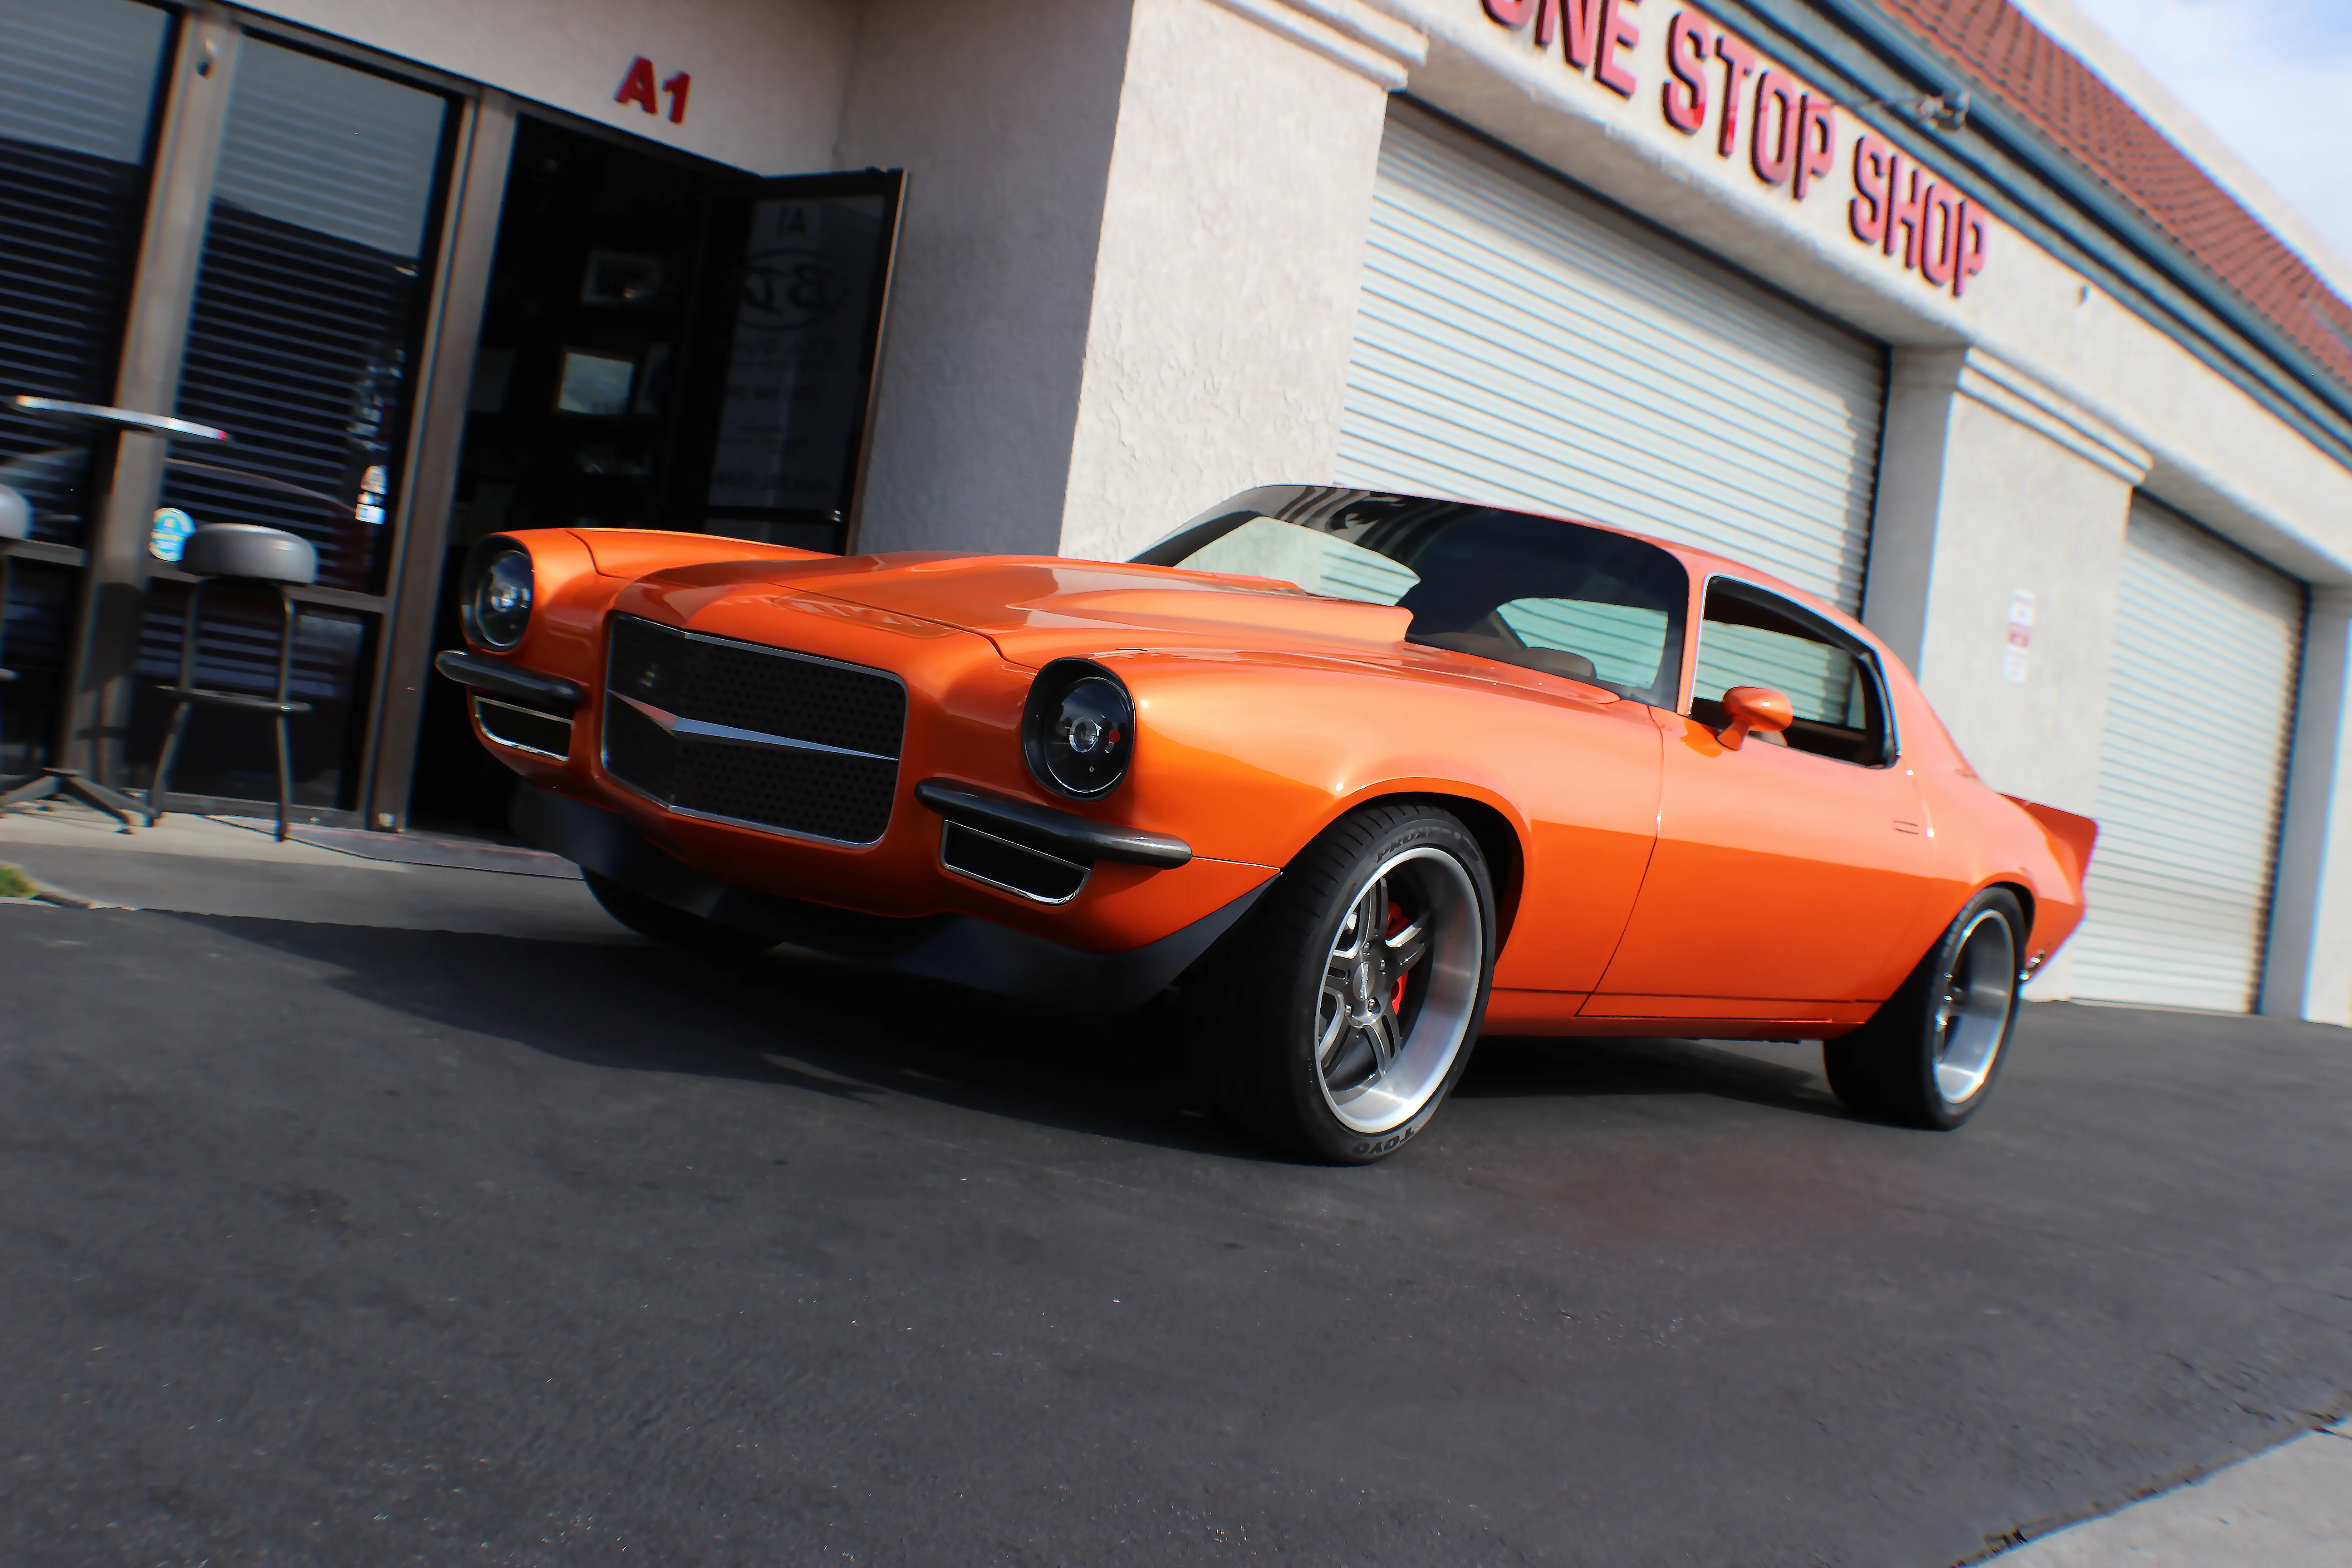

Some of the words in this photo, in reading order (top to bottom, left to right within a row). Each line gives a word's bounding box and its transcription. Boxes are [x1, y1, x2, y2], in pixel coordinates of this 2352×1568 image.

[613, 56, 691, 125] A1
[1662, 5, 1835, 201] STOP
[1849, 133, 1987, 299] SHOP
[1352, 1126, 1415, 1155] TOYO
